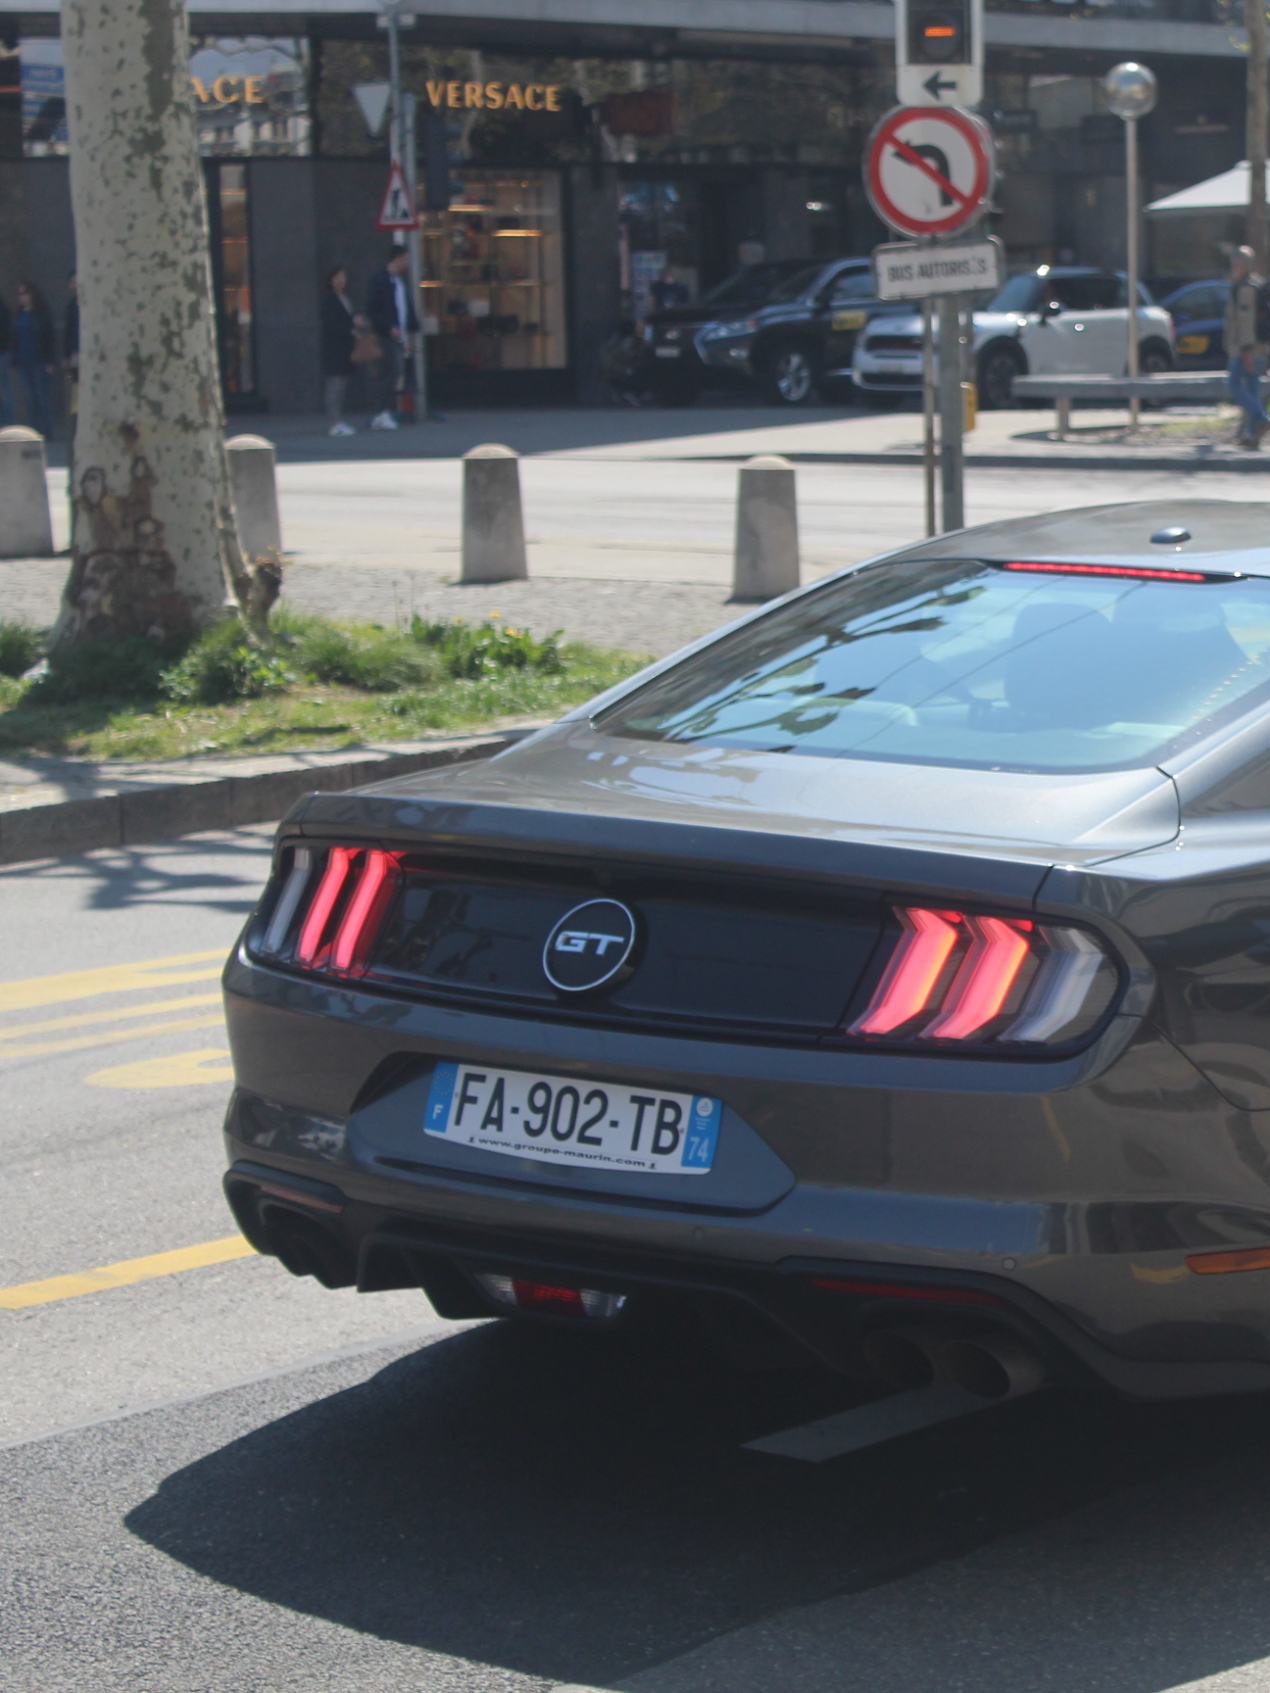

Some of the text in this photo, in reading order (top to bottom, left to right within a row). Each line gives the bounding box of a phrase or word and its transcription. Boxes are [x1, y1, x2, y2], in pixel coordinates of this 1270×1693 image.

[189, 74, 264, 104] ACE
[425, 79, 562, 112] VERSACE
[887, 264, 914, 283] BUS
[555, 931, 624, 955] GT
[433, 1104, 443, 1119] F
[454, 1073, 682, 1155] FA-902-TB
[478, 1138, 646, 1167] www.groupe-maurin.com
[689, 1136, 709, 1162] 74
